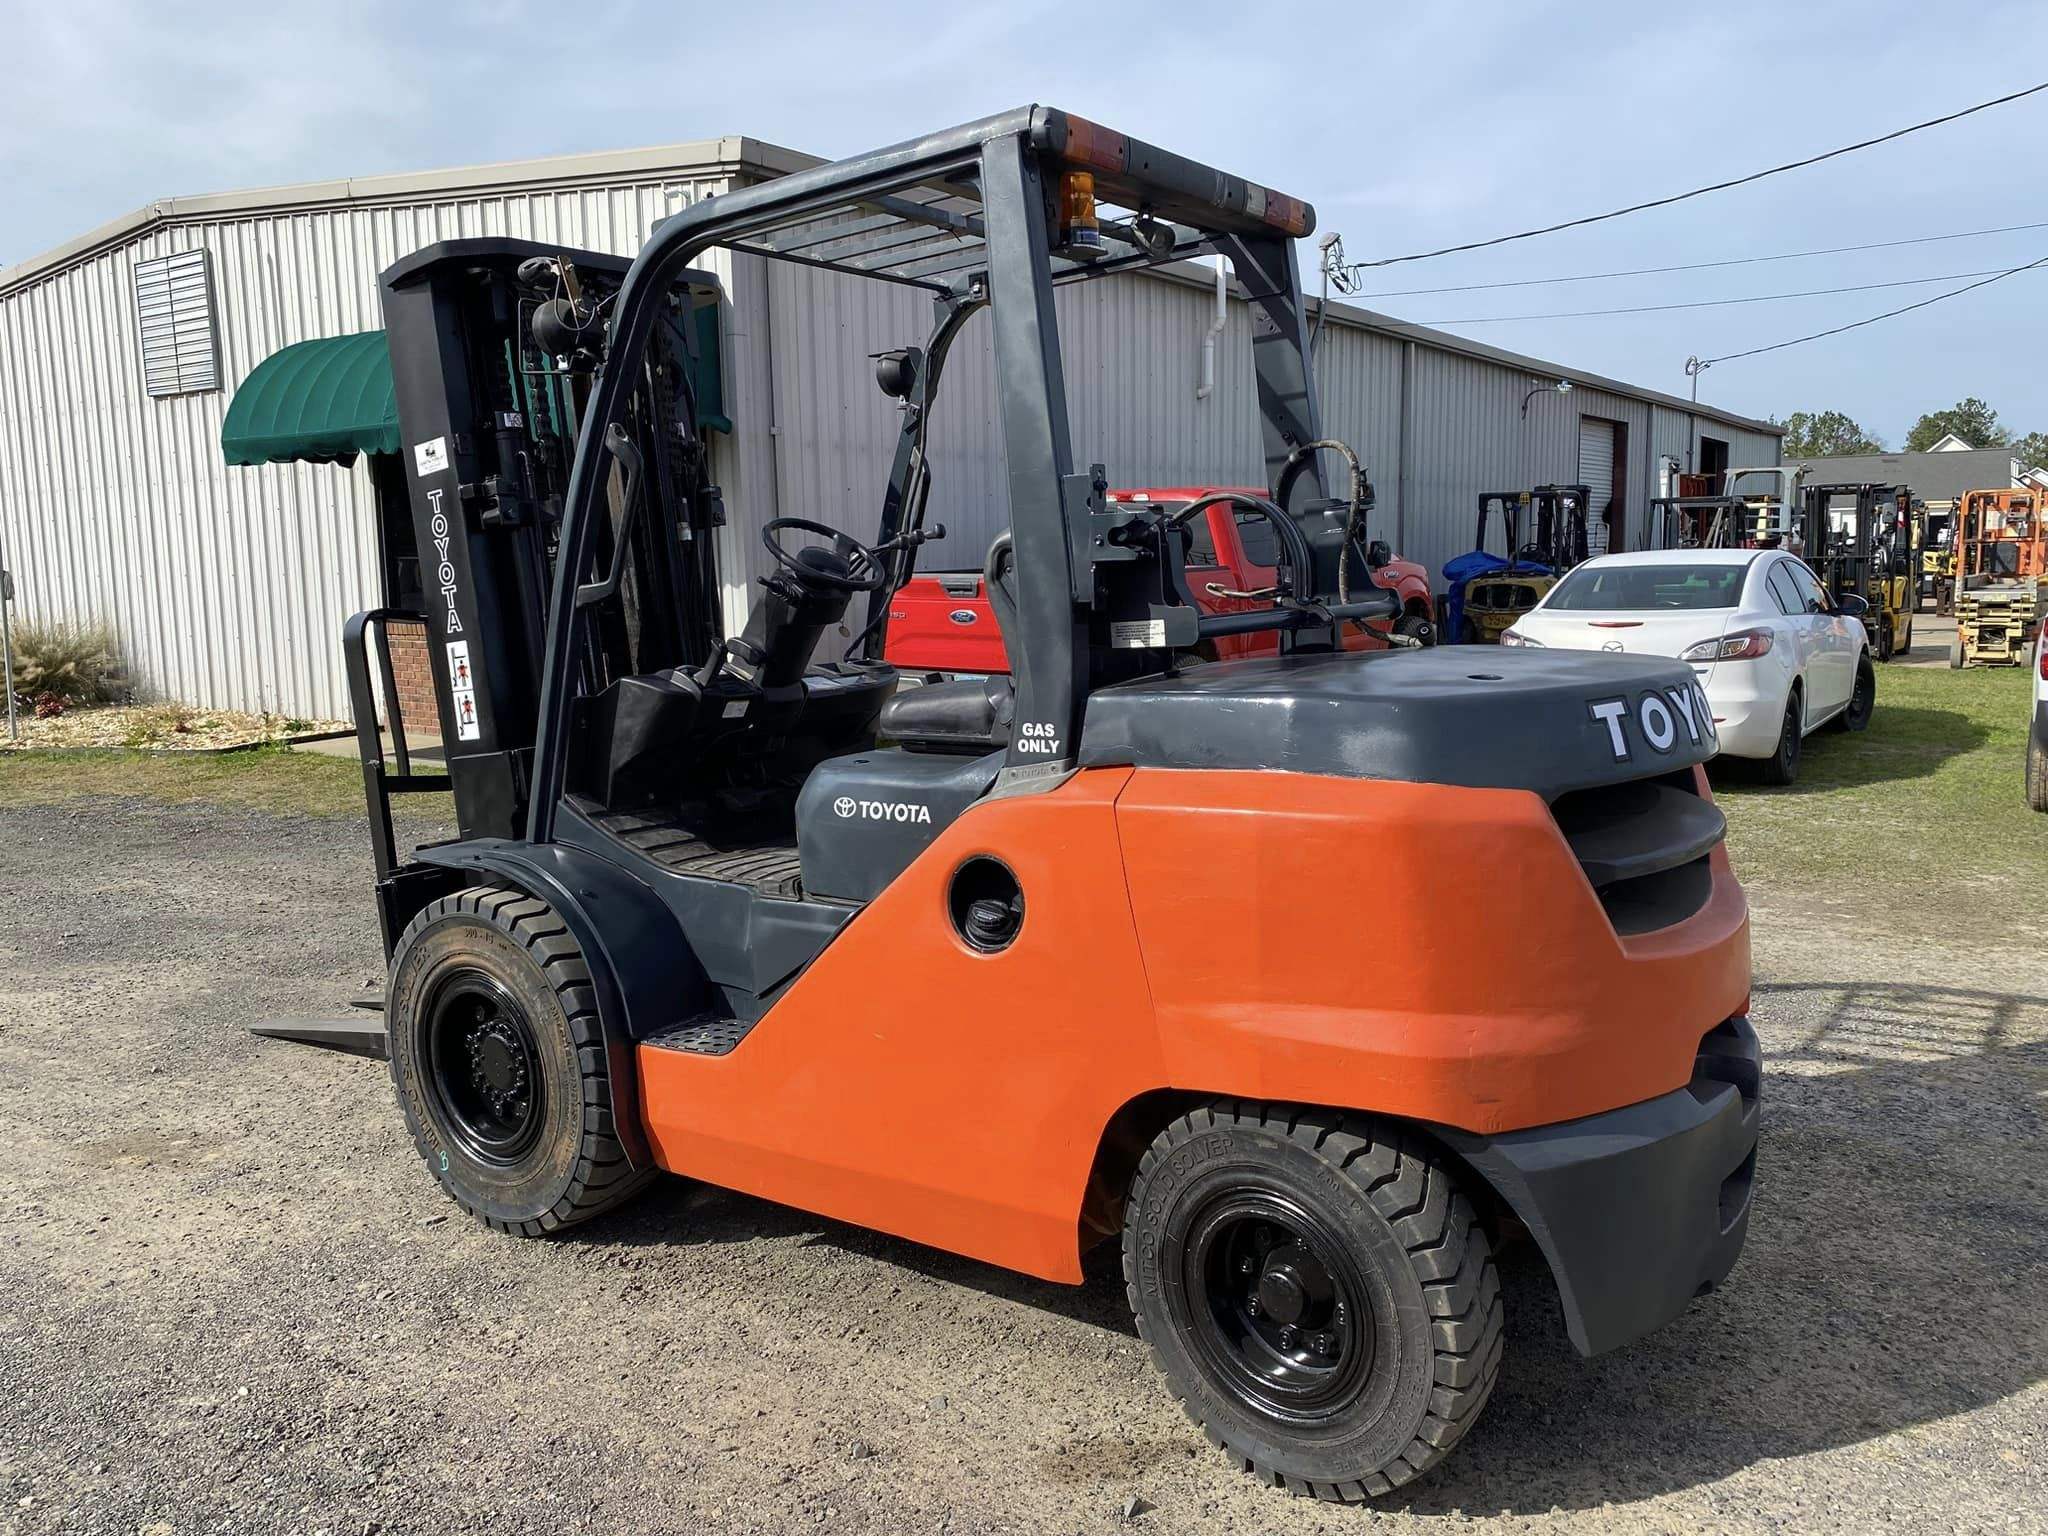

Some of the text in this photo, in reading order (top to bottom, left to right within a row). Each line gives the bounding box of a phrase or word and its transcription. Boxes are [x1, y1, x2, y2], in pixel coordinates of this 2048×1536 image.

[427, 489, 463, 633] TOYOTA
[1022, 723, 1055, 737] GAS
[1592, 684, 1716, 757] TOYO
[1017, 739, 1060, 754] ONLY
[859, 801, 931, 824] TOYOTA
[1142, 1138, 1234, 1297] NITCO SOLID SOLVER
